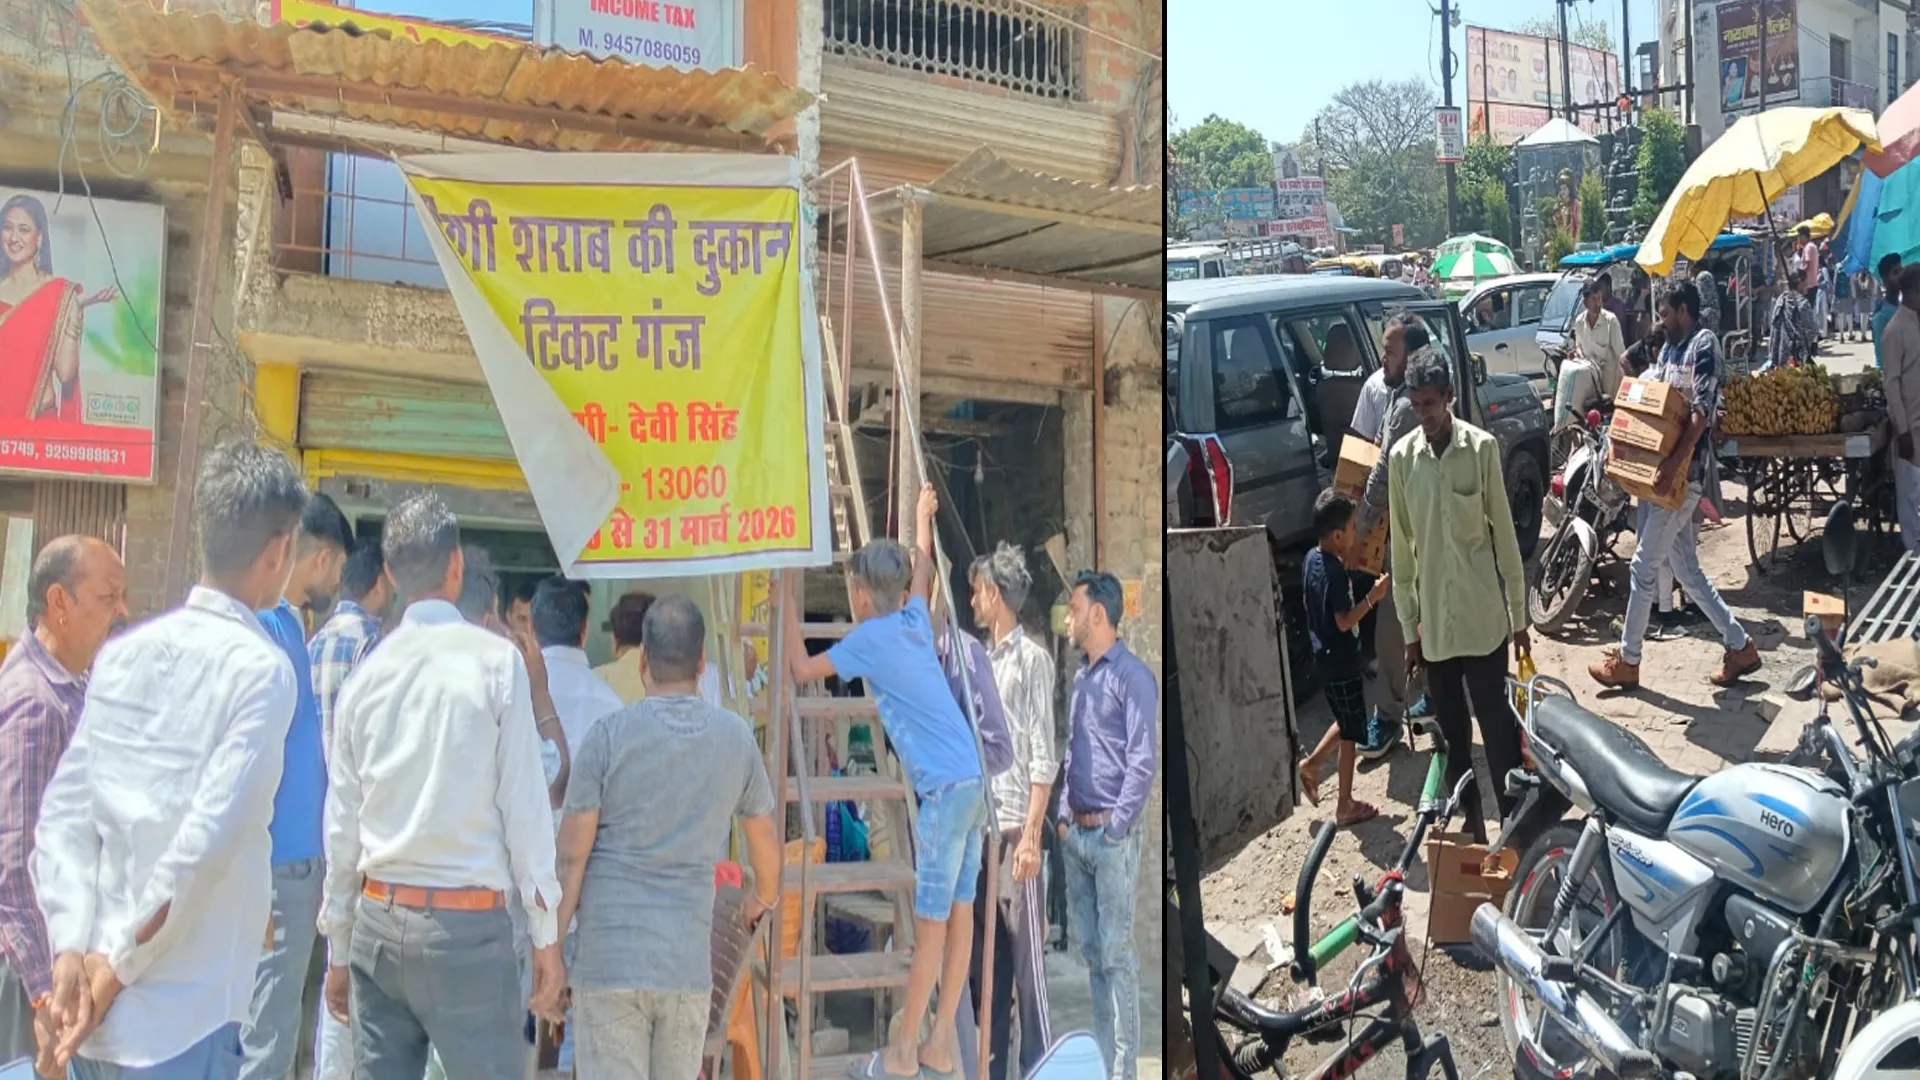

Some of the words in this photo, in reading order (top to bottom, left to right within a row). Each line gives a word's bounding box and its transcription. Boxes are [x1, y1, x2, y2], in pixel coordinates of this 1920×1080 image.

[590, 0, 659, 22] INCOME
[664, 4, 695, 29] TAX
[579, 27, 598, 49] M.
[604, 32, 701, 65] 9457086059
[509, 216, 615, 274] शराब
[624, 203, 677, 274] की
[689, 220, 792, 296] दुकान
[520, 298, 622, 372] टिकट
[633, 298, 705, 372] गंज
[628, 401, 678, 443] देवी
[687, 401, 739, 443] सिंह
[641, 464, 727, 501] 13060
[610, 507, 635, 549] से
[643, 515, 671, 549] 31
[680, 501, 731, 547] मार्च
[737, 504, 796, 543] 2026
[1760, 809, 1794, 838] Hero
